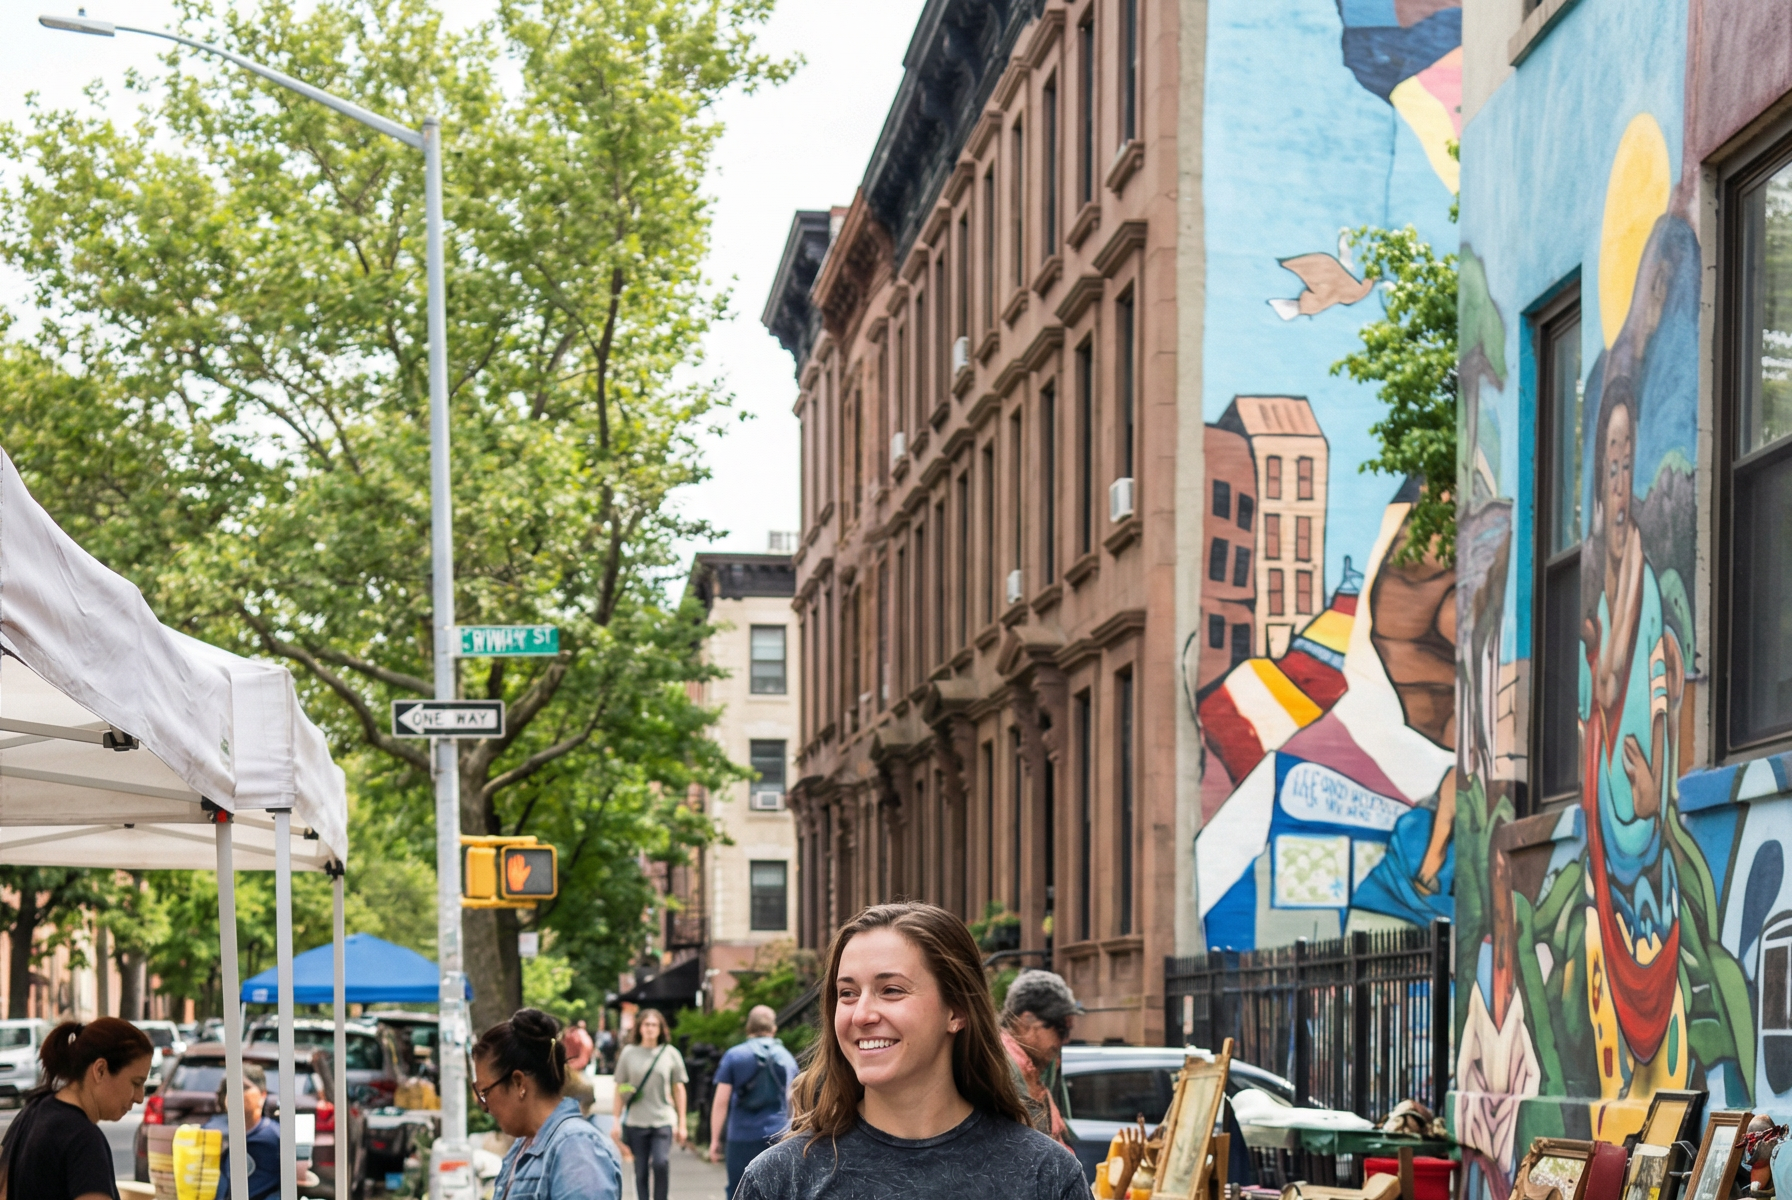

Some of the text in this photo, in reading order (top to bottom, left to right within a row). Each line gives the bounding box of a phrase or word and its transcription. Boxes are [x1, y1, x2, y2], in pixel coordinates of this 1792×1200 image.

[533, 628, 554, 645] ST
[412, 712, 488, 726] ONE WAY
